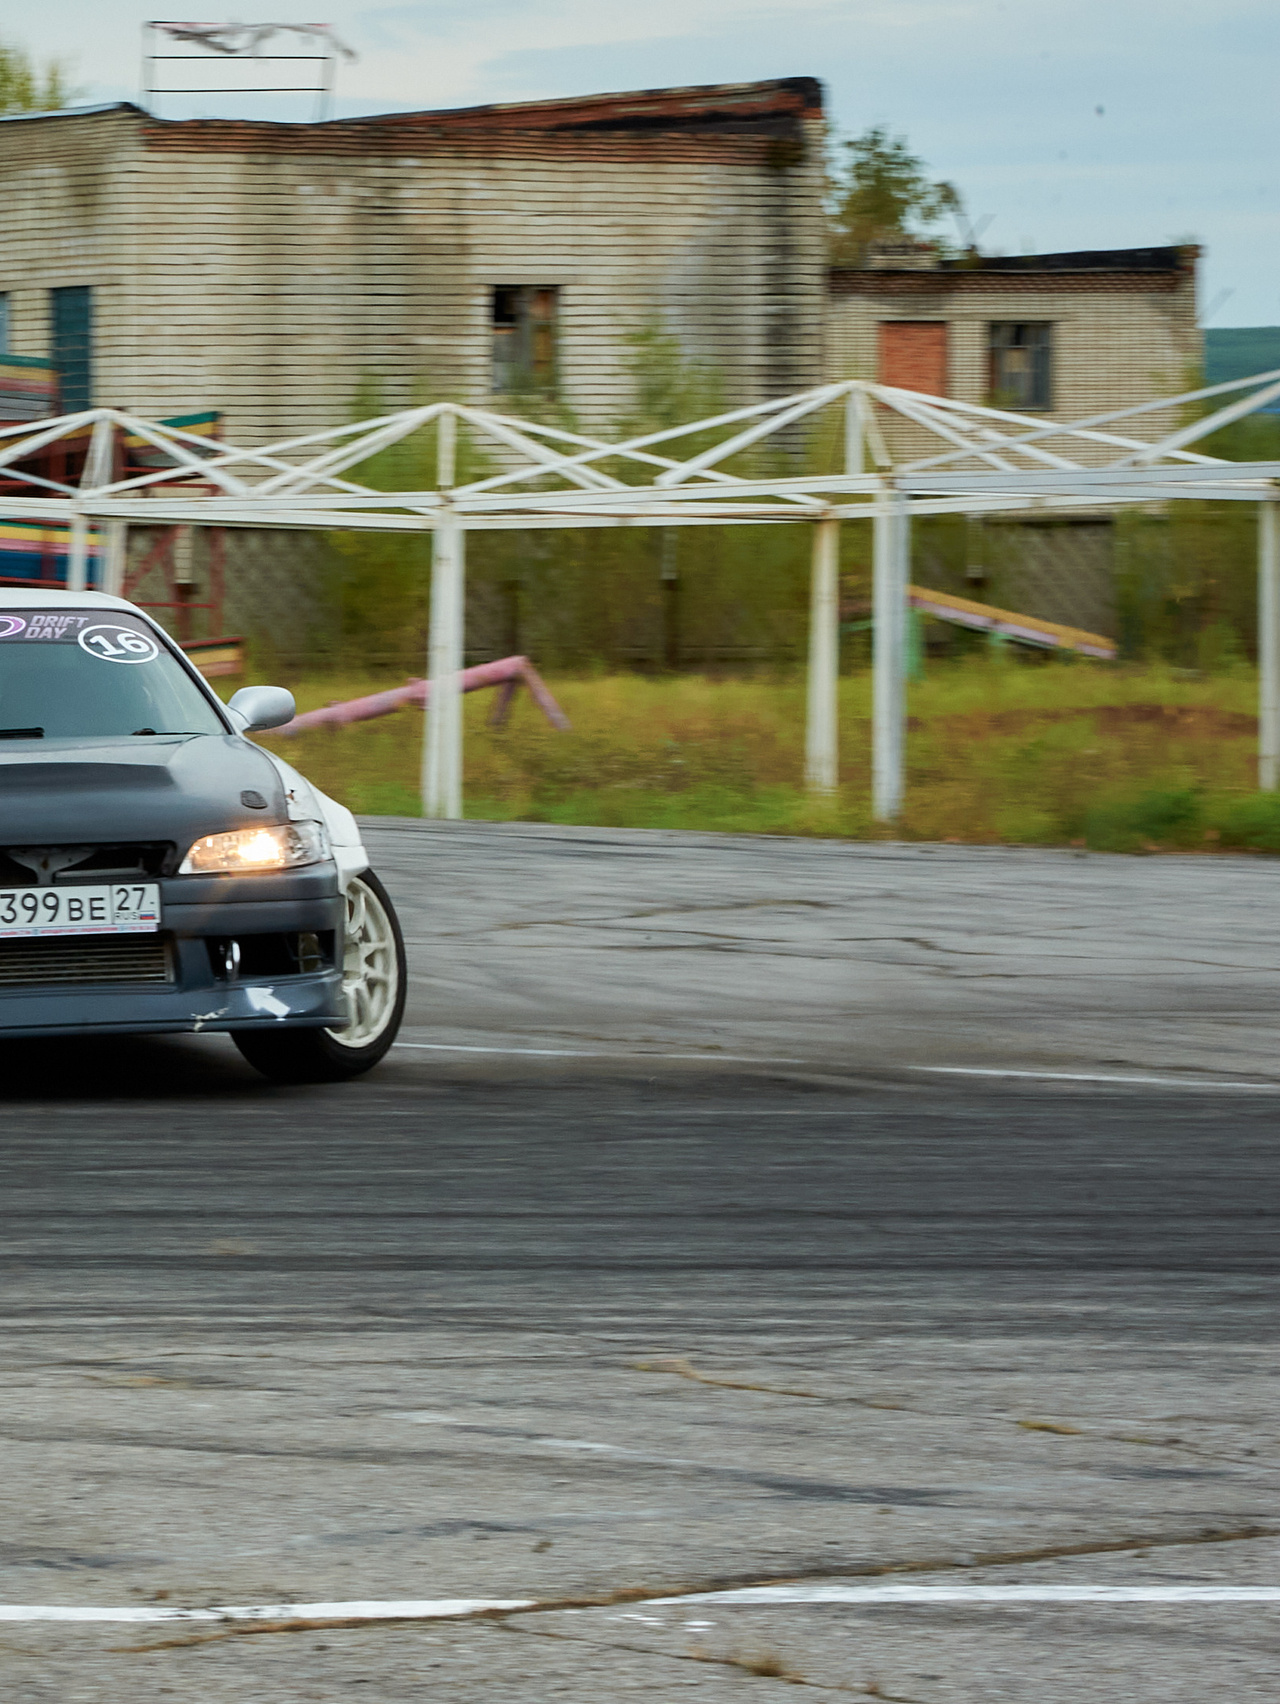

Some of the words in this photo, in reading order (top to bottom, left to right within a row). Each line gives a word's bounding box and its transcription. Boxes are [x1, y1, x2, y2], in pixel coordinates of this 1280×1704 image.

[30, 615, 89, 628] DRIFT
[24, 627, 67, 639] DAY
[89, 632, 150, 656] 16
[115, 887, 146, 911] 27
[114, 911, 138, 921] RUS
